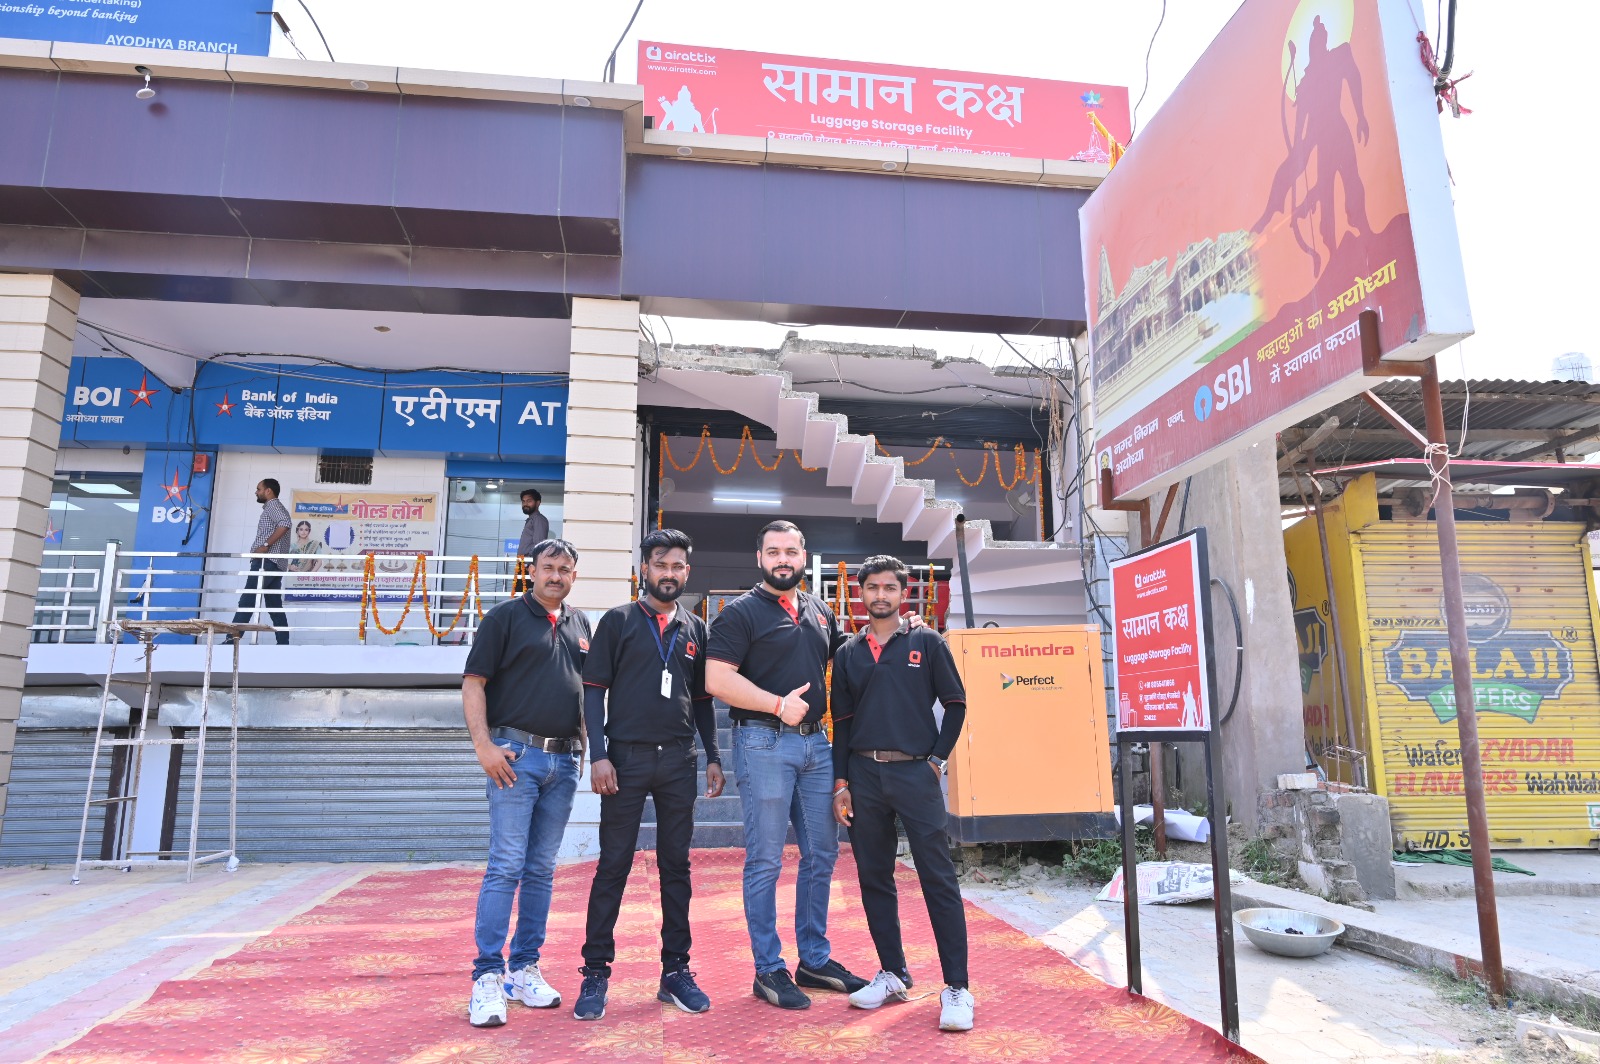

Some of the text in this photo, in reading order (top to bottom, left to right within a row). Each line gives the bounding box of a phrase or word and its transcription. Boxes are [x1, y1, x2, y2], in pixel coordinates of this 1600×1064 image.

[47, 5, 91, 18] beyond
[92, 9, 138, 23] banking
[105, 34, 238, 54] AYODHYA BRANCH
[664, 50, 716, 64] airattix
[647, 64, 717, 76] www.airattix.com
[761, 62, 1024, 128] सामान कक्ष
[811, 113, 973, 140] Luggage Storage Facility
[1306, 309, 1323, 330] का
[1327, 259, 1397, 319] अयोध्या
[1269, 363, 1281, 384] में
[1283, 343, 1322, 377] स्वागत
[1213, 356, 1252, 411] SBI
[73, 386, 122, 407] BOI
[241, 389, 338, 405] Bank of India
[65, 411, 125, 424] अयोध्या शाखा
[244, 403, 265, 418] बैंक
[296, 406, 332, 422] इंडिया
[392, 387, 501, 429] एटीएम
[518, 400, 568, 426] AT
[1113, 434, 1133, 455] नगर
[1134, 417, 1159, 444] निगम
[1115, 448, 1145, 476] अयोध्या
[151, 506, 192, 524] BOI
[352, 499, 425, 520] गोल्ड लोन
[1121, 603, 1189, 640] सामान कक्ष
[980, 644, 1075, 657] Mahindra
[1123, 643, 1193, 666] Luggage Storage Facility
[1016, 675, 1055, 686] Perfect
[1439, 687, 1532, 711] WFERS
